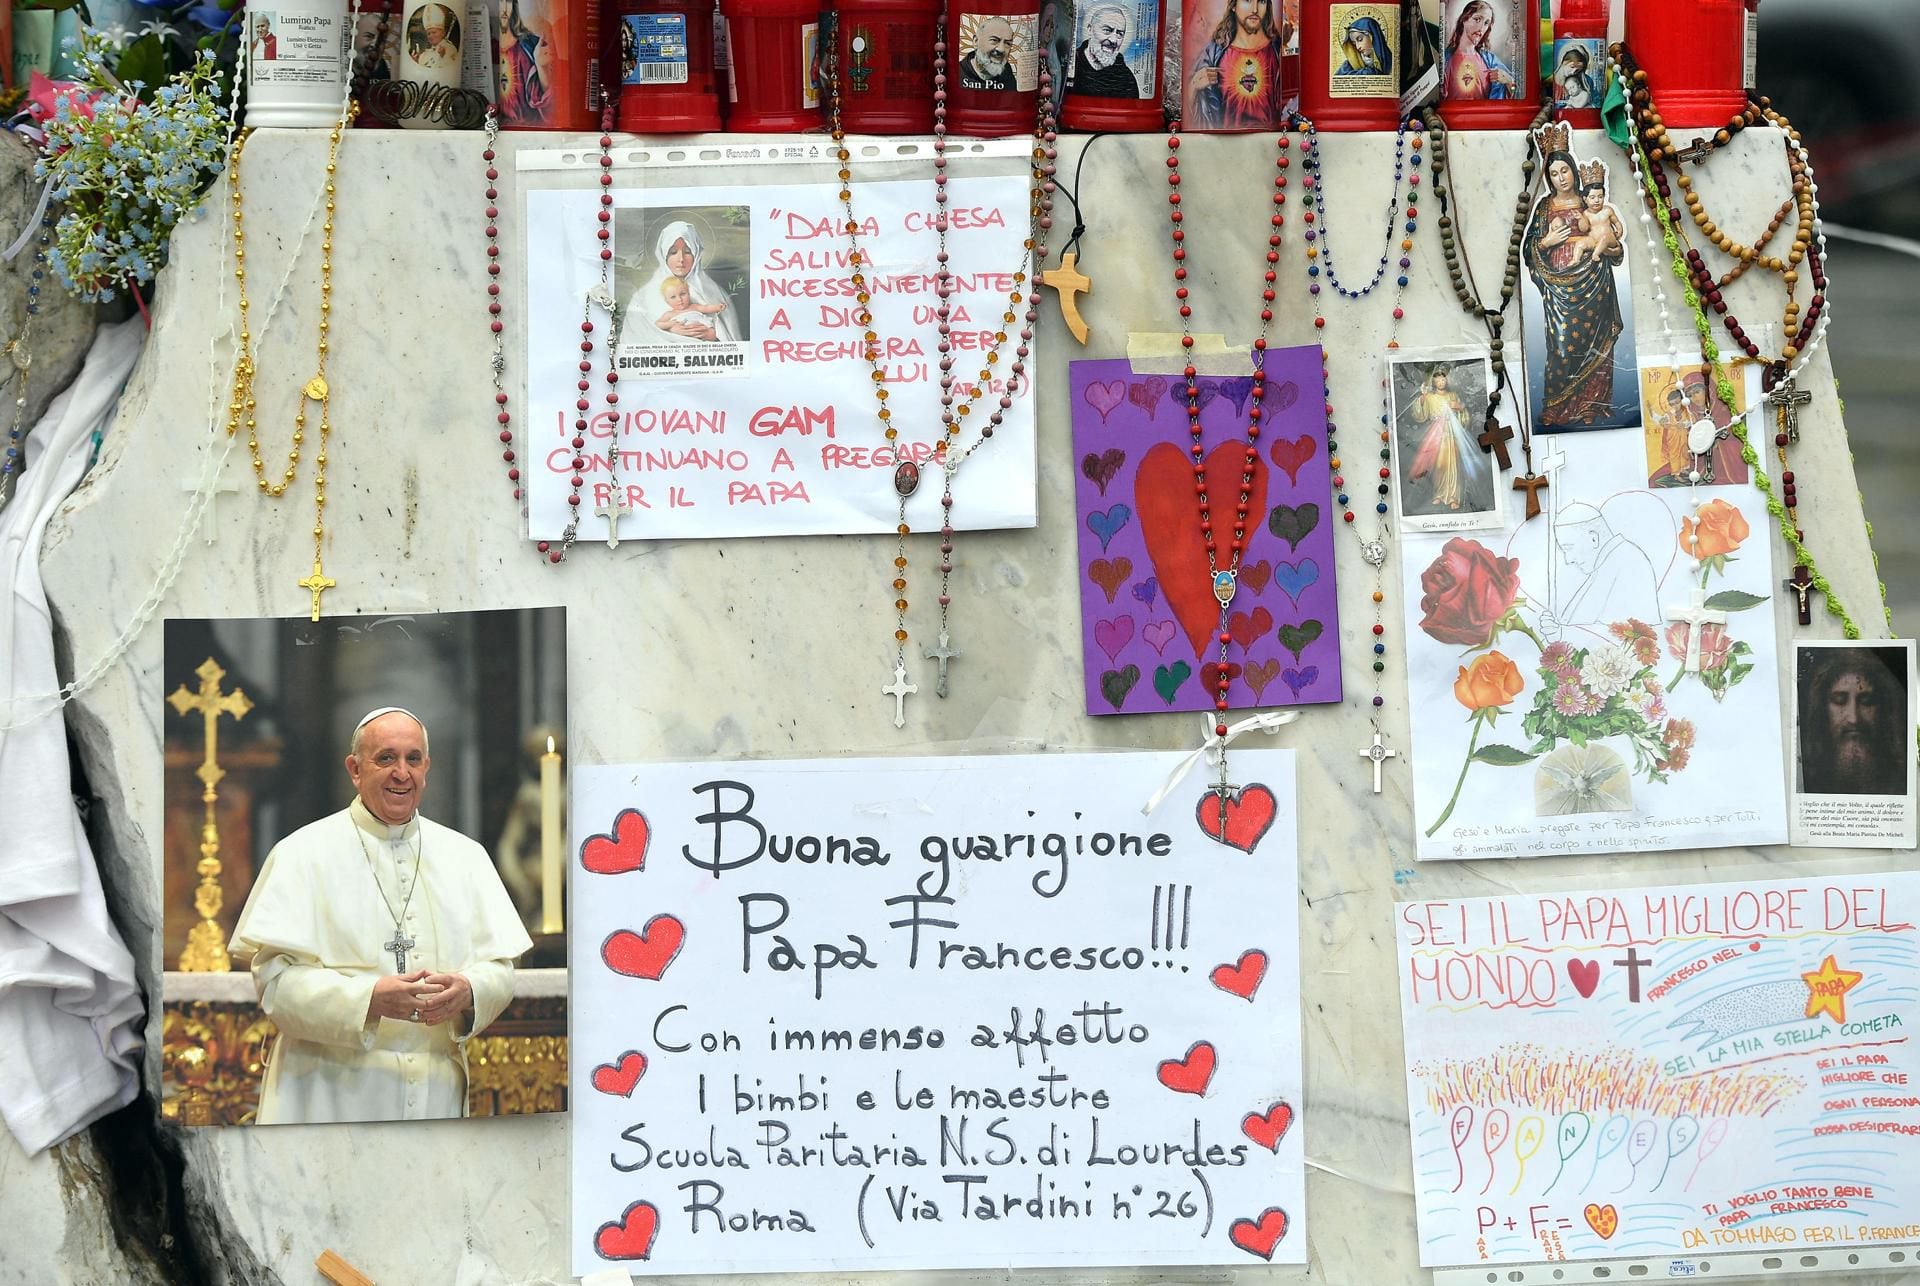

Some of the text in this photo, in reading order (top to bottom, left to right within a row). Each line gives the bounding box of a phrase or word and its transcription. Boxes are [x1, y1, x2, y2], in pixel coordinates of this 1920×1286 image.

[280, 16, 332, 26] Lumino Papa
[962, 78, 1005, 90] San Pio
[764, 248, 873, 270] SALIVA
[760, 273, 1014, 299] INCESSANTEMENTE
[769, 304, 971, 330] A DIO UNA
[763, 330, 998, 363] PREGHIERA PER
[619, 354, 744, 368] SIGNORE, SALVACI!
[882, 362, 927, 382] LUI
[558, 405, 835, 438] I GIOVANI GAM
[546, 447, 749, 473] CONTINUANO
[771, 448, 794, 472] A
[670, 481, 811, 508] IL PAPA
[682, 780, 1174, 898] Buona guarigione
[1494, 824, 1531, 835] Maria
[1540, 823, 1582, 837] pregate
[1589, 821, 1608, 832] per
[1611, 818, 1641, 831] Papa
[1643, 815, 1700, 829] Francesco
[1713, 814, 1731, 824] per
[1472, 842, 1518, 854] ammalati
[1527, 841, 1546, 851] nel
[1550, 841, 1580, 853] corpo
[1403, 887, 1910, 946] SEI IL PAPA MIGLIORE DEL
[738, 883, 1192, 1000] Papa Francesco!!!
[1411, 955, 1556, 1003] MONDO
[1647, 948, 1743, 1002] FRANCESCO NEL
[1816, 978, 1845, 998] PAPA
[653, 1000, 1149, 1068] Con immenso affetto
[1663, 1013, 1903, 1077] SEI LA MIA STELLA COMETA
[1816, 1054, 1889, 1069] SEI IL PAPA
[699, 1066, 1110, 1114] I bimbi e le maestre
[1881, 1073, 1908, 1085] CHE
[1823, 1097, 1920, 1110] OGNI PERSONA
[611, 1122, 750, 1172] Scuola
[756, 1119, 927, 1168] Paritaria
[1087, 1116, 1249, 1167] Lourdes
[678, 1179, 816, 1234] Roma
[858, 1174, 943, 1248] (Via
[943, 1173, 1092, 1219] Tardini
[1148, 1168, 1214, 1238] 26)
[1702, 1185, 1874, 1216] TI VOGLIO TANTO BENE
[1719, 1200, 1848, 1227] PAPA FRANCESCO
[1477, 1206, 1496, 1235] P
[1529, 1205, 1549, 1239] F
[1682, 1227, 1708, 1248] DA
[1710, 1225, 1796, 1245] TOMMASO
[1804, 1228, 1833, 1243] PER
[1838, 1226, 1854, 1241] IL
